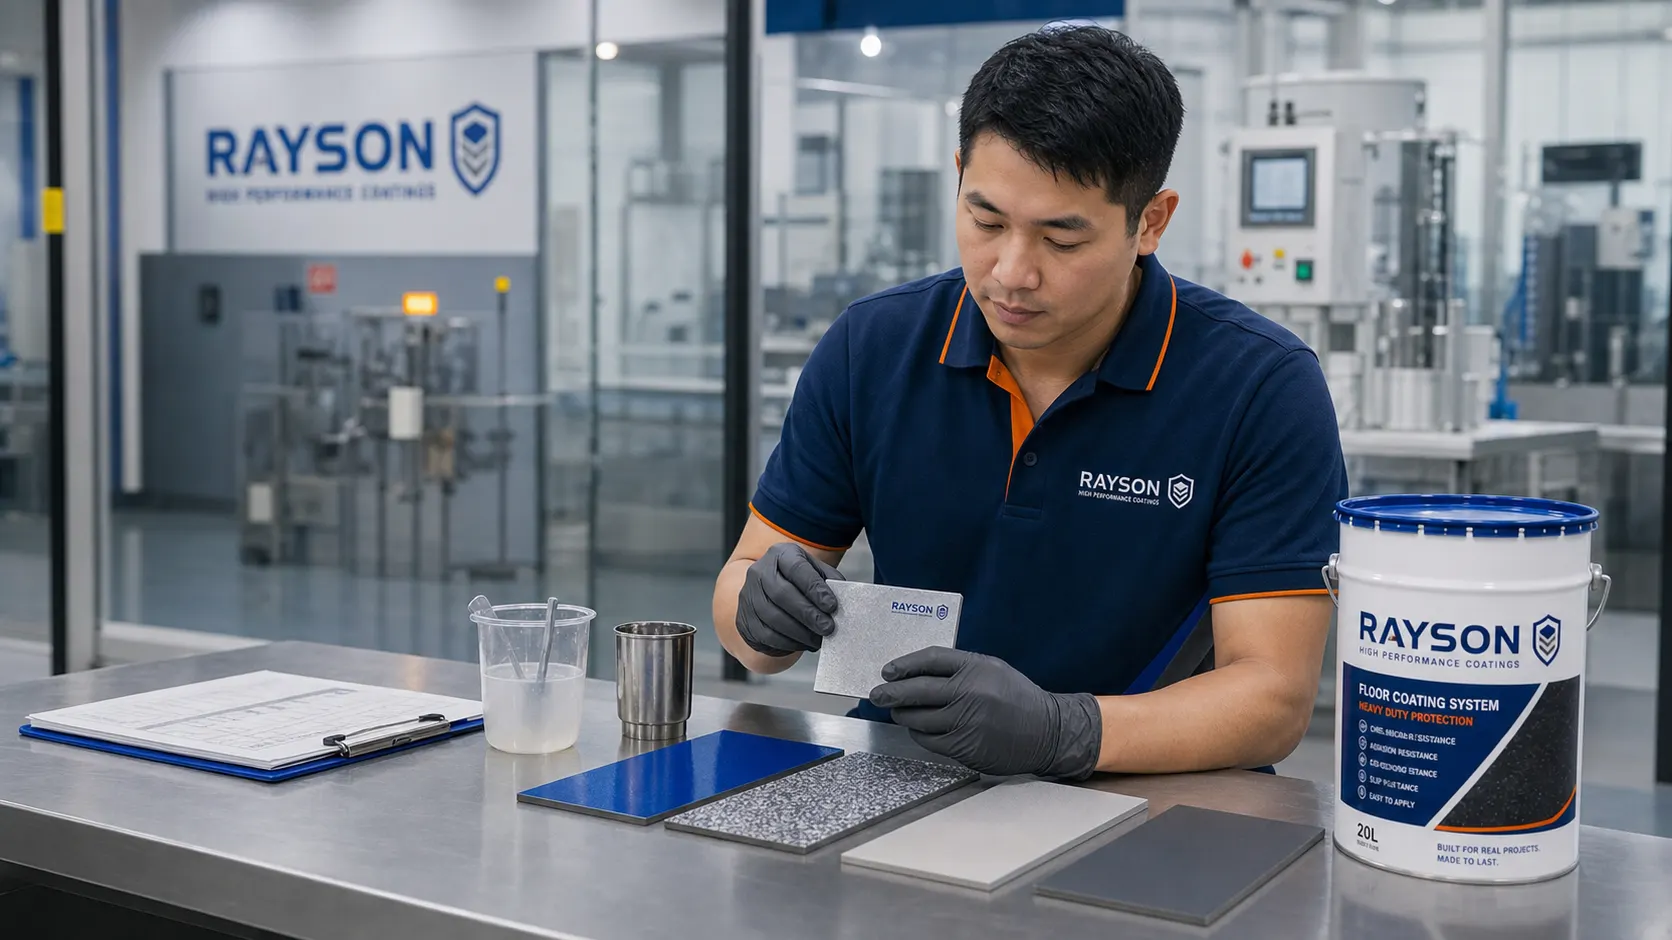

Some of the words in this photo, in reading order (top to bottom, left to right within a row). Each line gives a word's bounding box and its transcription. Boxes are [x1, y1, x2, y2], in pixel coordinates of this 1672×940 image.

[206, 119, 435, 177] RAYSON
[1080, 470, 1160, 496] RAYSON
[891, 601, 933, 614] RAYSON
[1359, 611, 1520, 655] RAYSON
[1359, 646, 1379, 658] HIGH
[1382, 650, 1460, 668] PERFORMANCE
[1466, 660, 1520, 669] COATINGS
[1359, 683, 1390, 702] FLOOR
[1392, 691, 1446, 709] COATING
[1450, 698, 1500, 712] SYSTEM
[1359, 701, 1383, 715] HEAVY
[1385, 708, 1409, 720] DUTY
[1411, 712, 1474, 726] PROTECTION
[1369, 792, 1384, 802] EASY
[1385, 796, 1393, 805] TO
[1394, 799, 1415, 808] APPLY
[1357, 822, 1379, 843] 20L
[1437, 843, 1460, 853] BUILT
[1462, 845, 1479, 854] FOR
[1481, 846, 1501, 855] REAL
[1503, 845, 1541, 855] PROJECTS.
[1437, 855, 1460, 865] MADE
[1463, 857, 1475, 866] TO
[1477, 858, 1499, 866] LAST.
